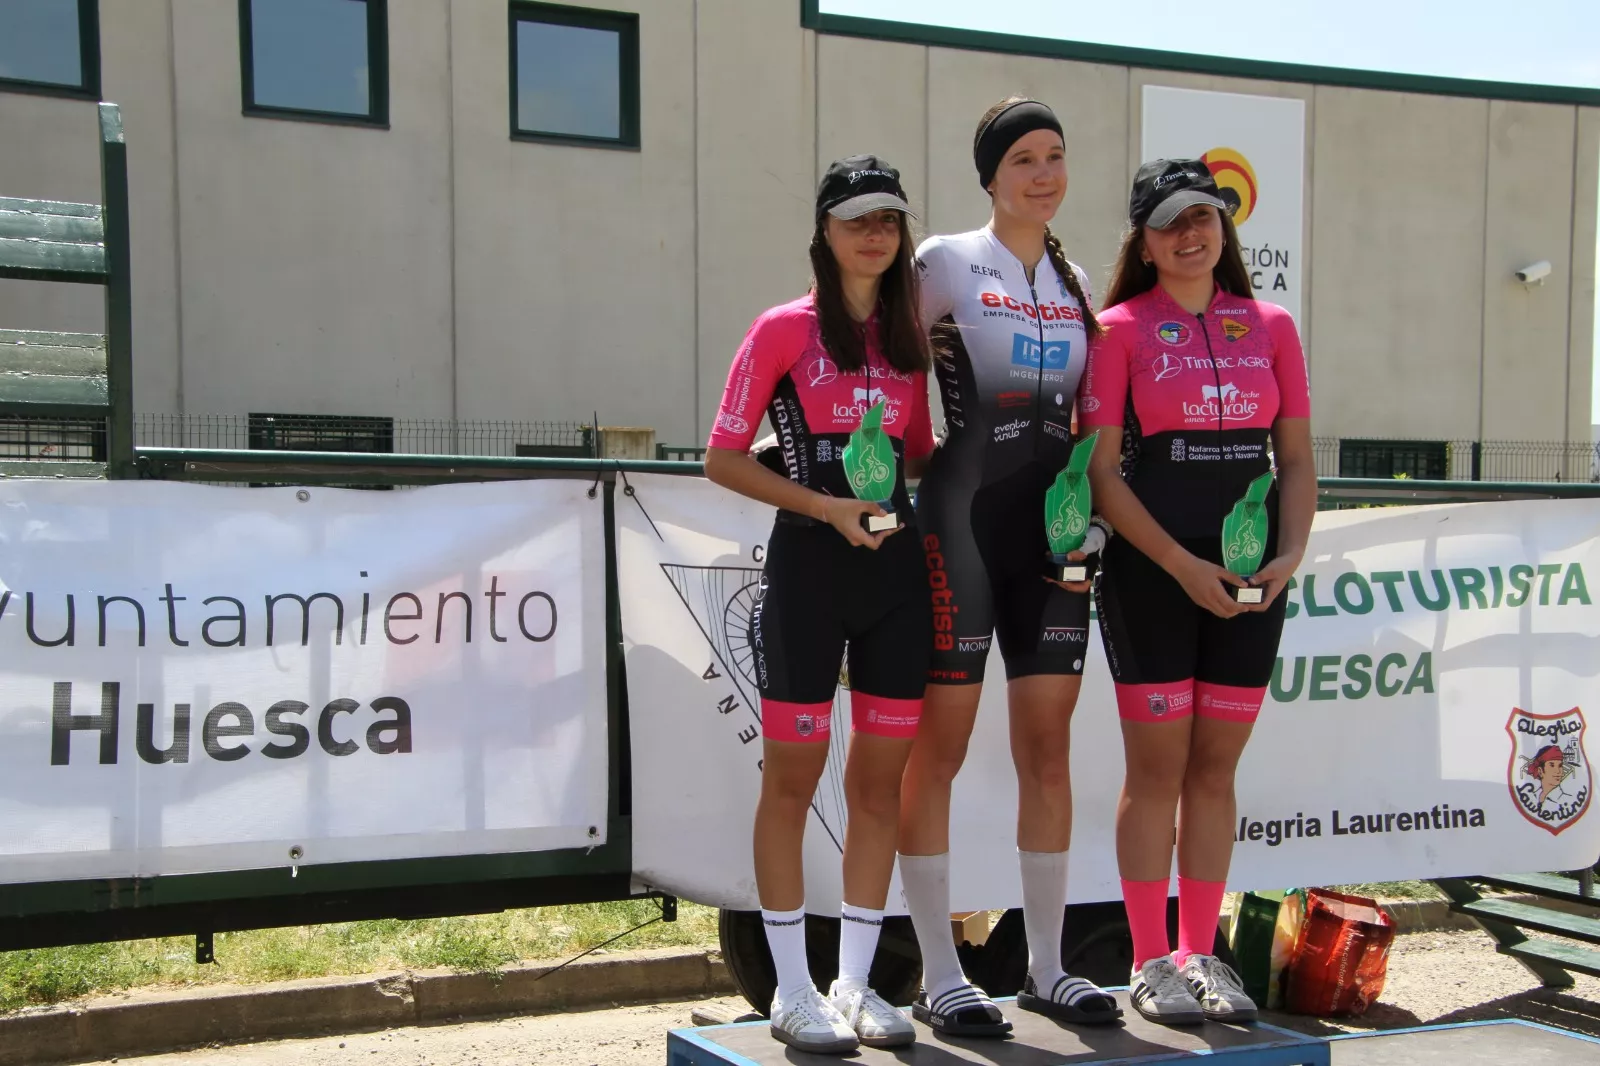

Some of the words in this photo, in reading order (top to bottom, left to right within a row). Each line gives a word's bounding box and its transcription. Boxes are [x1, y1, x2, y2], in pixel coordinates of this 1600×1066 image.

[981, 292, 1083, 322] ecotisa
[983, 310, 1026, 322] EMPRESA
[1022, 341, 1061, 364] IDC
[1183, 356, 1235, 369] Timac
[1237, 356, 1270, 369] AGRO
[1009, 369, 1064, 382] INGENIEROS
[735, 377, 750, 415] Pamplona
[1182, 399, 1258, 417] lacturale
[1240, 390, 1260, 398] leche
[833, 403, 899, 420] lactale
[1188, 453, 1220, 461] Gobierno
[923, 533, 958, 651] ecotisa
[0, 571, 558, 647] untamiento
[753, 602, 763, 647] Timac
[757, 651, 768, 689] AGRO
[51, 681, 412, 765] Huesca
[1516, 782, 1587, 820] Laurentina
[1234, 813, 1321, 846] legria
[1332, 804, 1485, 836] Laurentina
